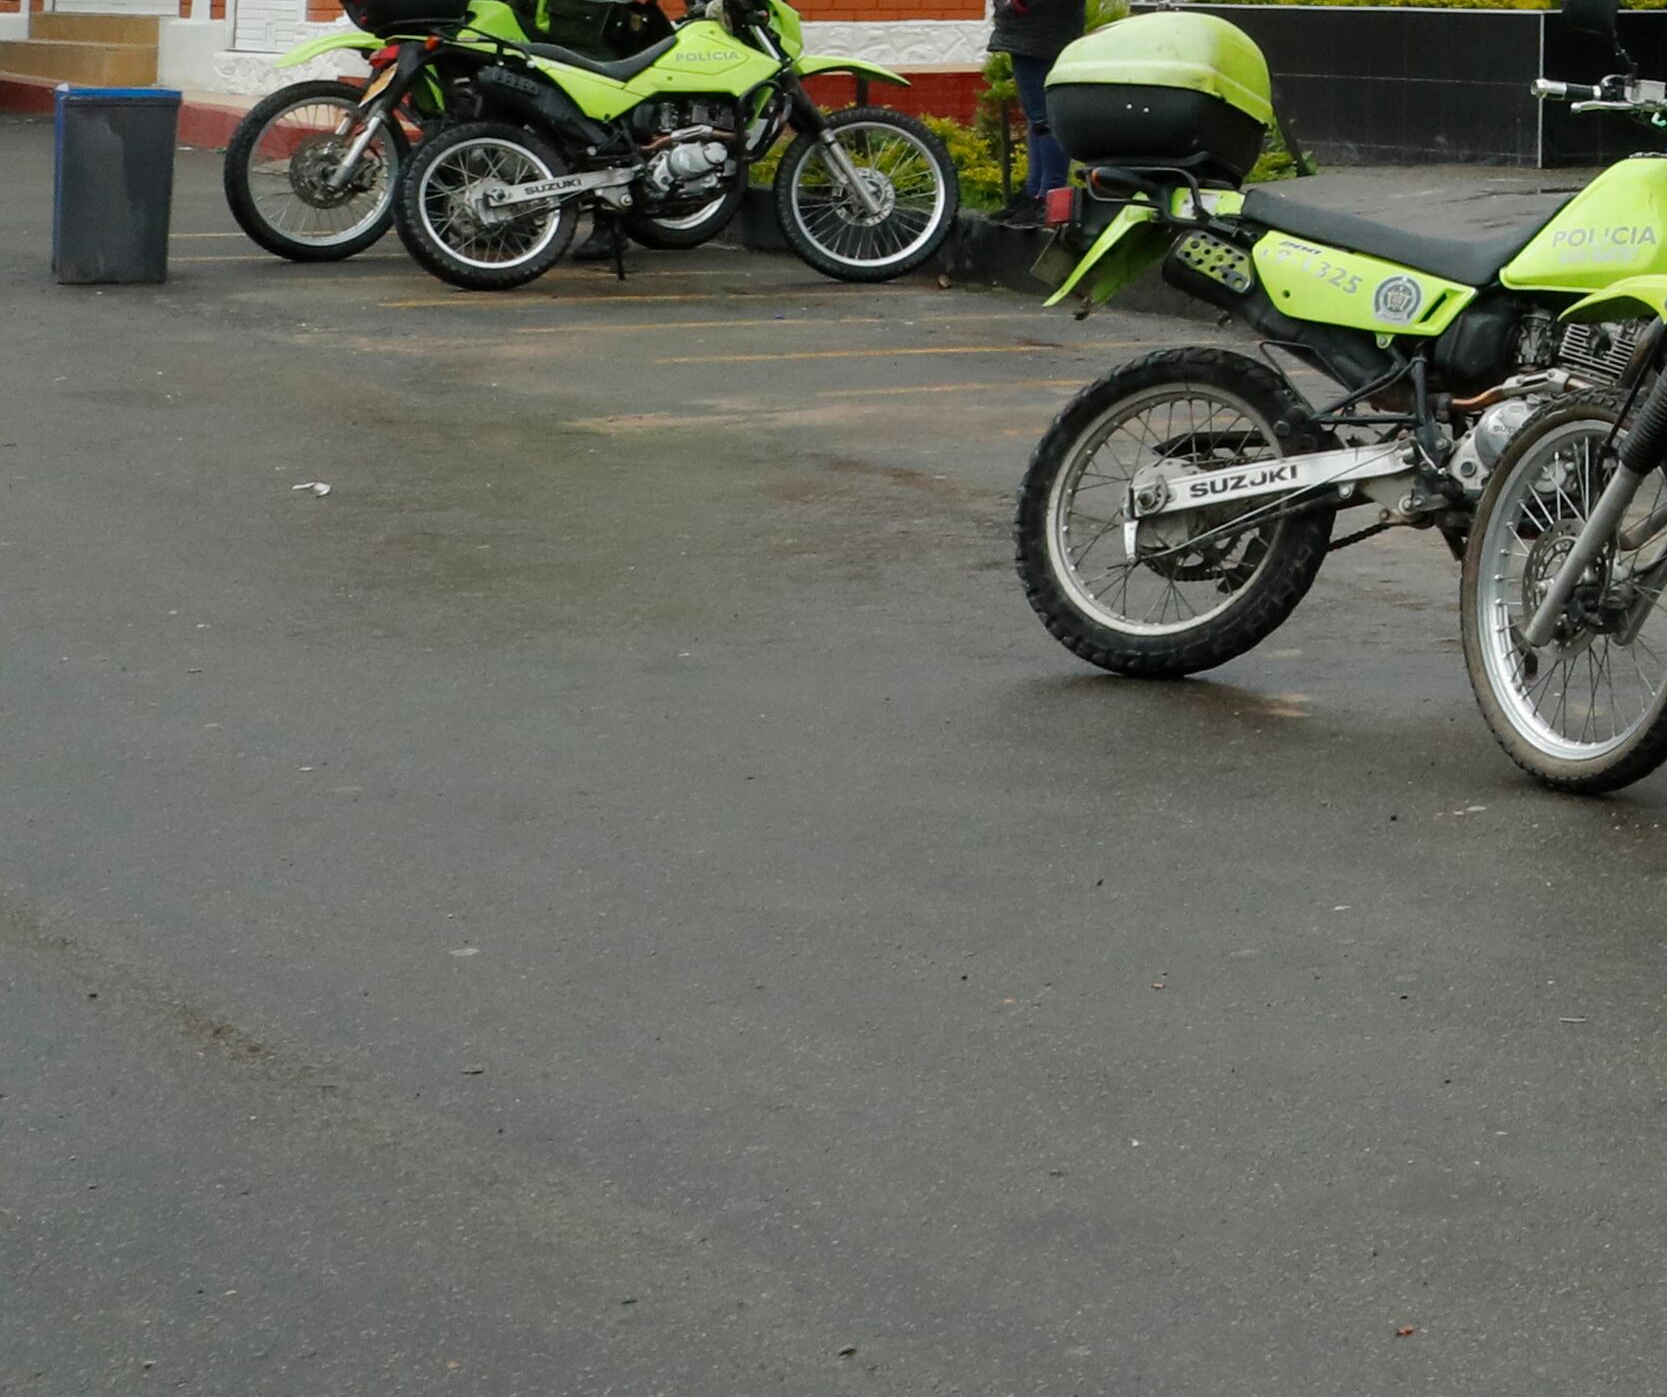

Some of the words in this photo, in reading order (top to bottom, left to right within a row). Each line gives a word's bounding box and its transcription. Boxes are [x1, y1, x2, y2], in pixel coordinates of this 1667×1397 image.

[675, 51, 739, 62] POLICIA
[523, 178, 583, 196] SUZUKI
[1552, 225, 1657, 249] POLICIA
[1189, 464, 1299, 499] SUZUKI
